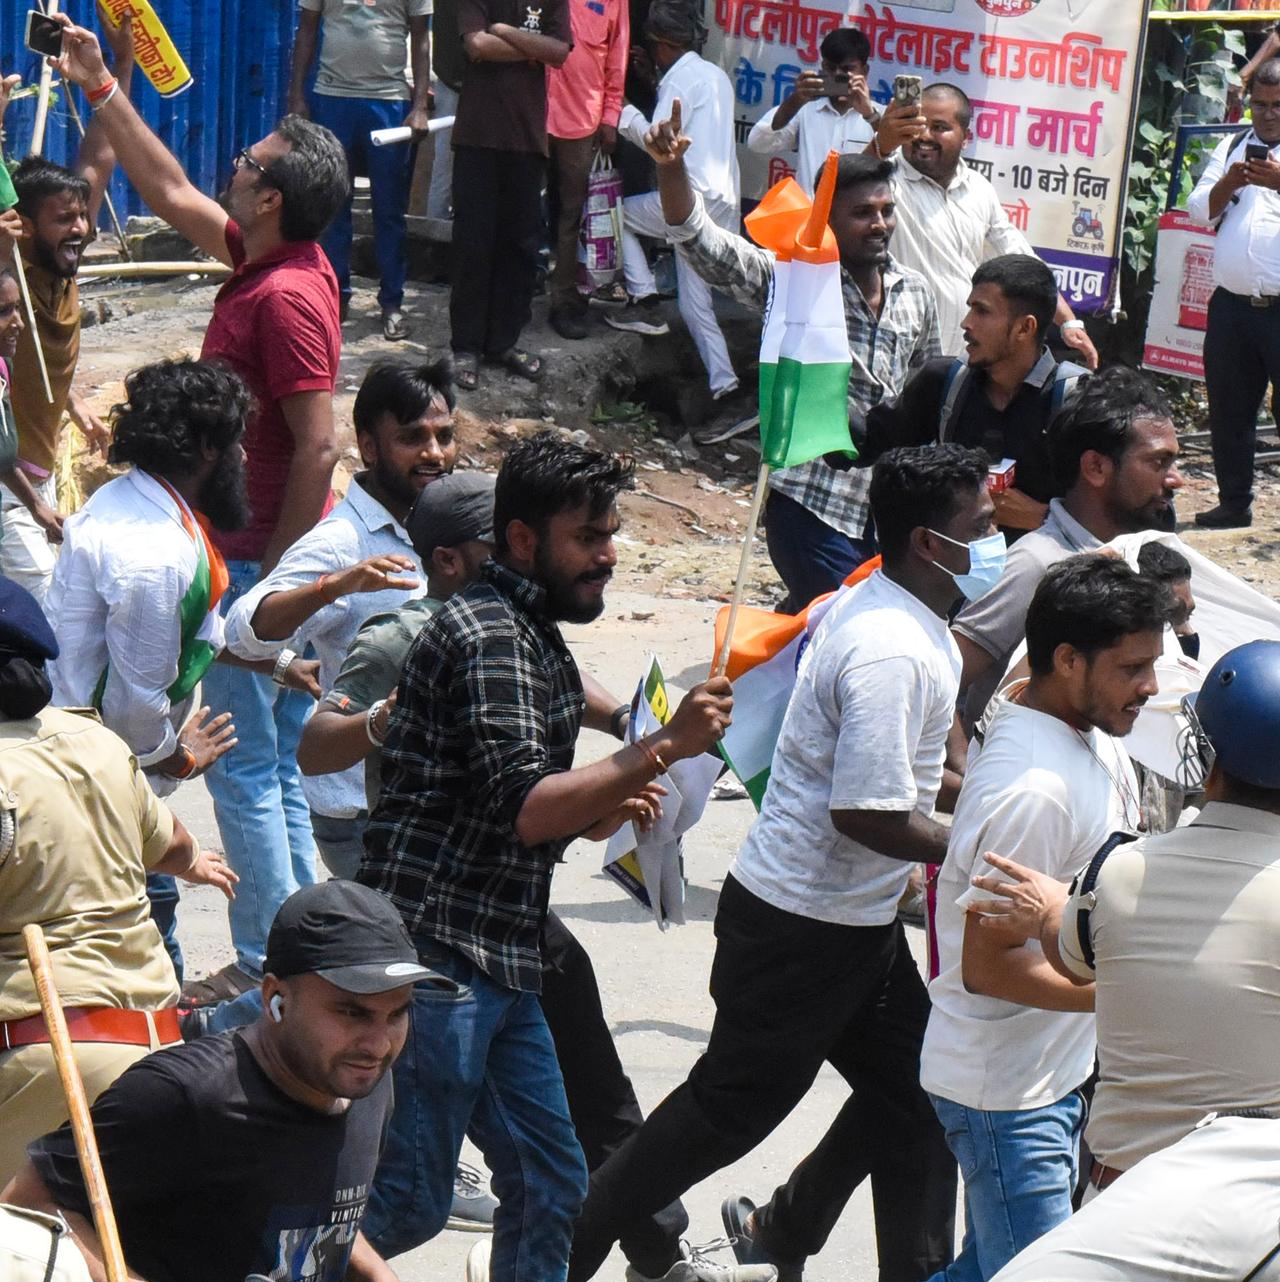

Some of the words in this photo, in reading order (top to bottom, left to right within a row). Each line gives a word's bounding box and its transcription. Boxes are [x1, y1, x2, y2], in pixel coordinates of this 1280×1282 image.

[734, 57, 766, 104] के
[979, 31, 1128, 93] टाउनशिप
[1027, 101, 1104, 157] मार्च
[962, 157, 994, 184] मय
[1011, 164, 1032, 190] 10
[1037, 164, 1069, 195] बजे
[1073, 166, 1110, 200] दिन
[1047, 263, 1105, 302] नपुन
